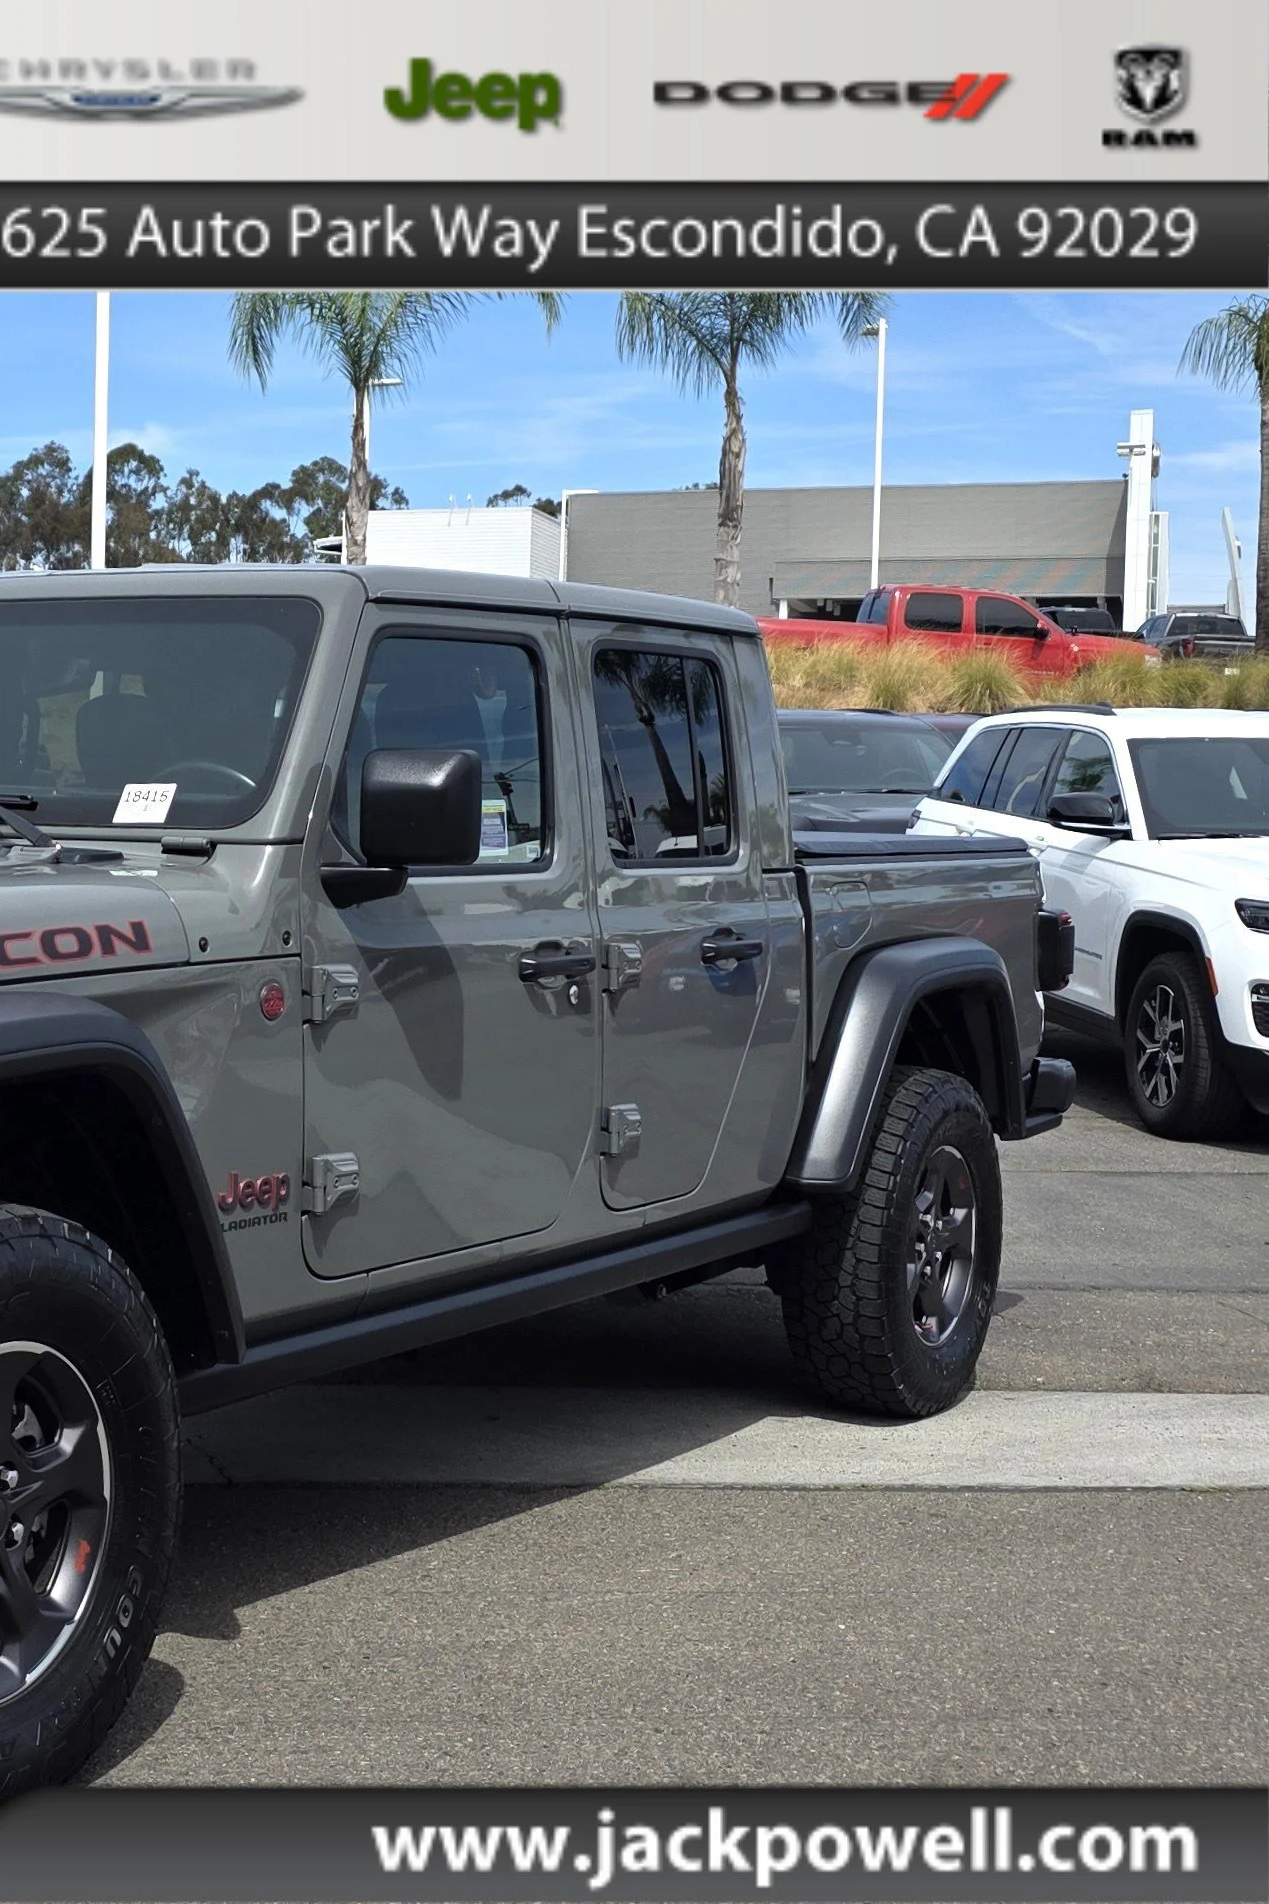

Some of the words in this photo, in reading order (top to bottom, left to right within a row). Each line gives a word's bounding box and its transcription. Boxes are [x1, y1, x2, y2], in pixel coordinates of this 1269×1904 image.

[124, 790, 170, 803] 18415
[217, 1171, 290, 1216] Jeep
[219, 1211, 289, 1233] LADIATOR
